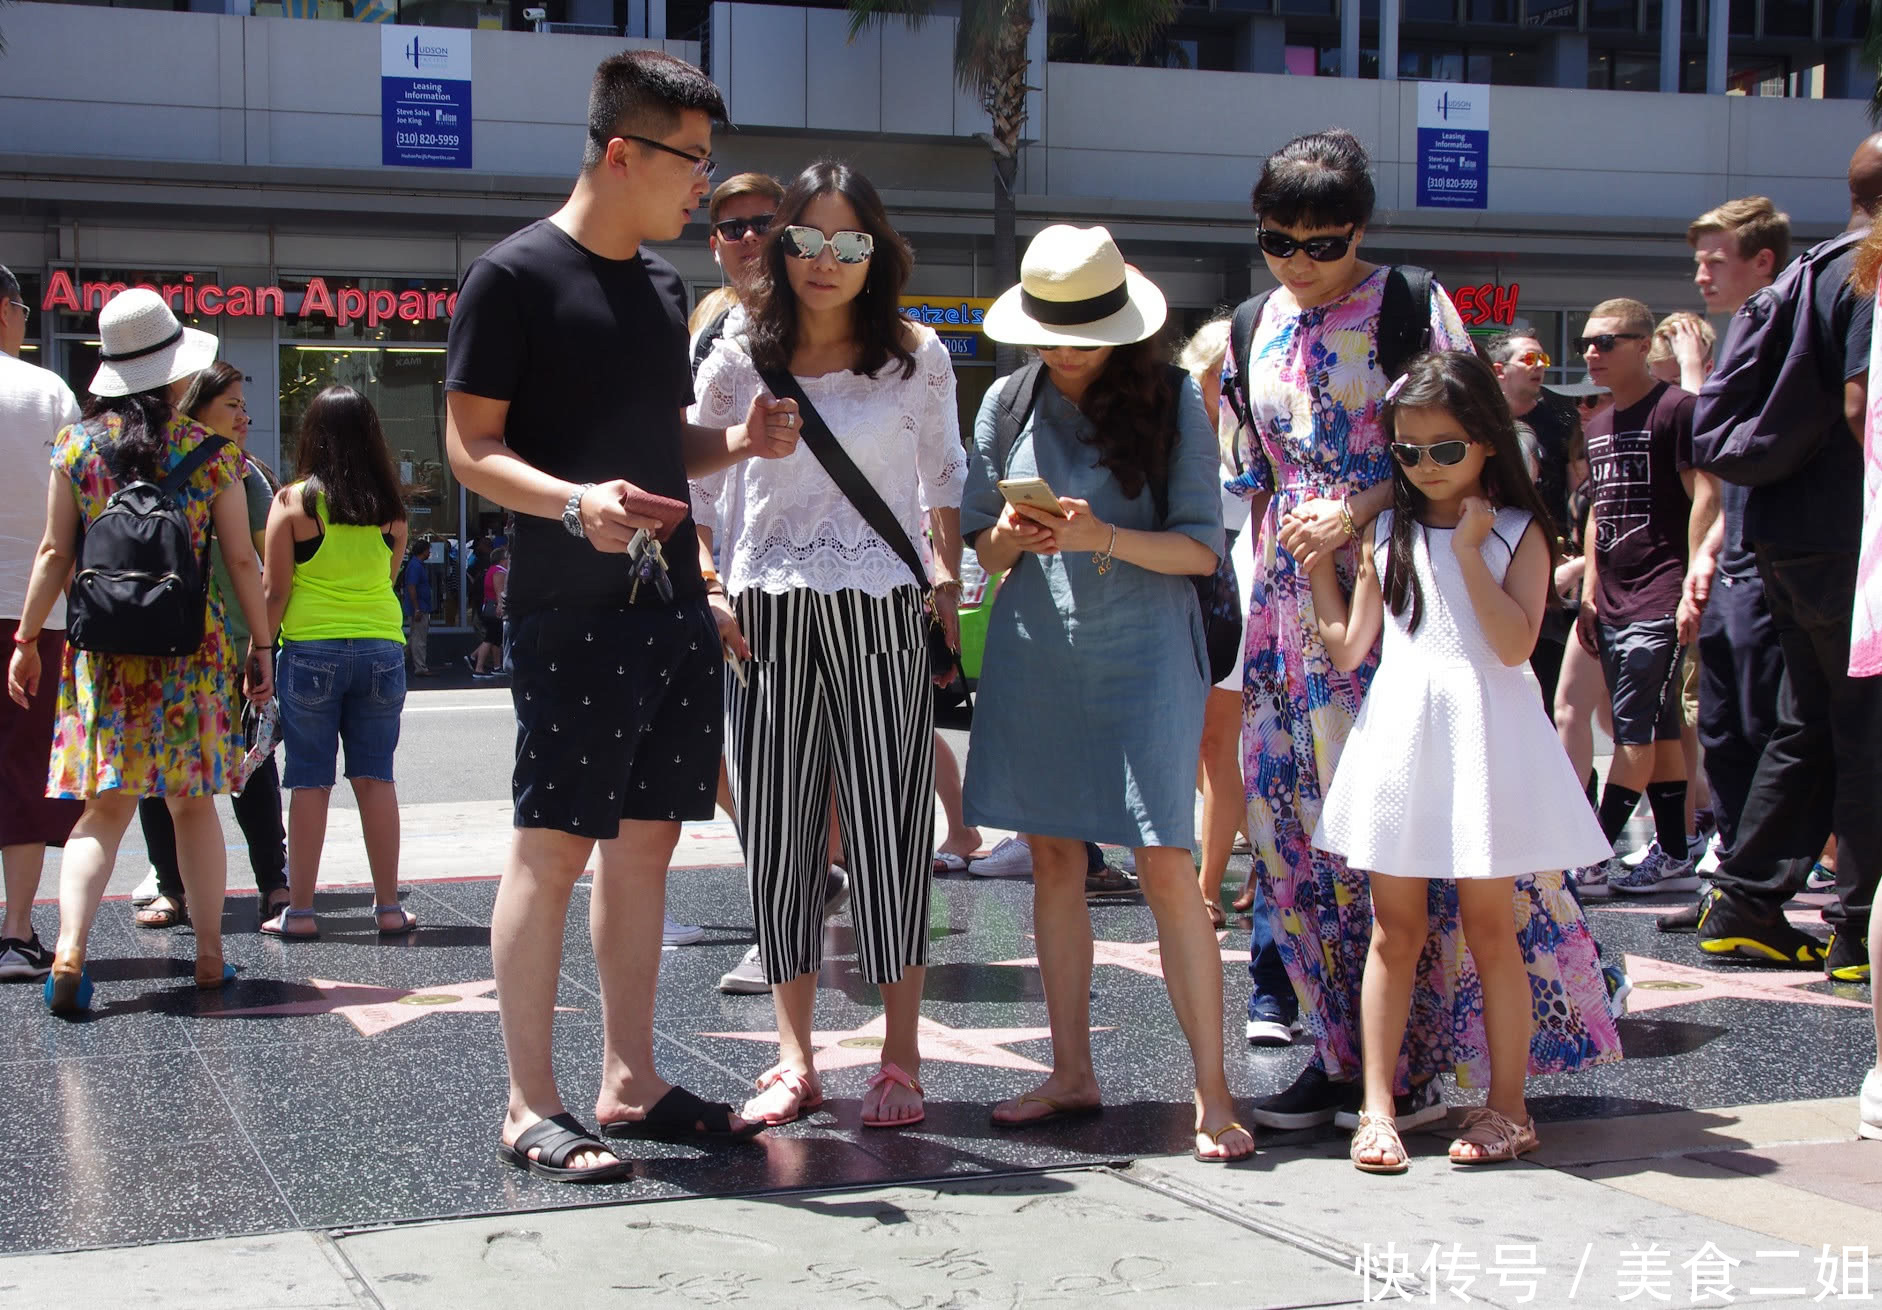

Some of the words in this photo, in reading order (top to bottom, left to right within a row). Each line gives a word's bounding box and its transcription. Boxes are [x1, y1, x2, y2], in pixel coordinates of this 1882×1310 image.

[406, 35, 448, 69] HUDSON
[413, 82, 442, 92] Leasing
[404, 91, 451, 101] Information
[396, 108, 414, 116] Steve
[408, 117, 423, 126] King
[396, 131, 418, 146] (310)
[419, 133, 459, 146] 820-5959
[1442, 132, 1466, 141] Leasing
[1435, 140, 1472, 149] Information
[1427, 176, 1445, 190] (310)
[1446, 178, 1478, 189] 820-5959
[41, 269, 285, 317] Amrican
[1448, 283, 1520, 326] ESH
